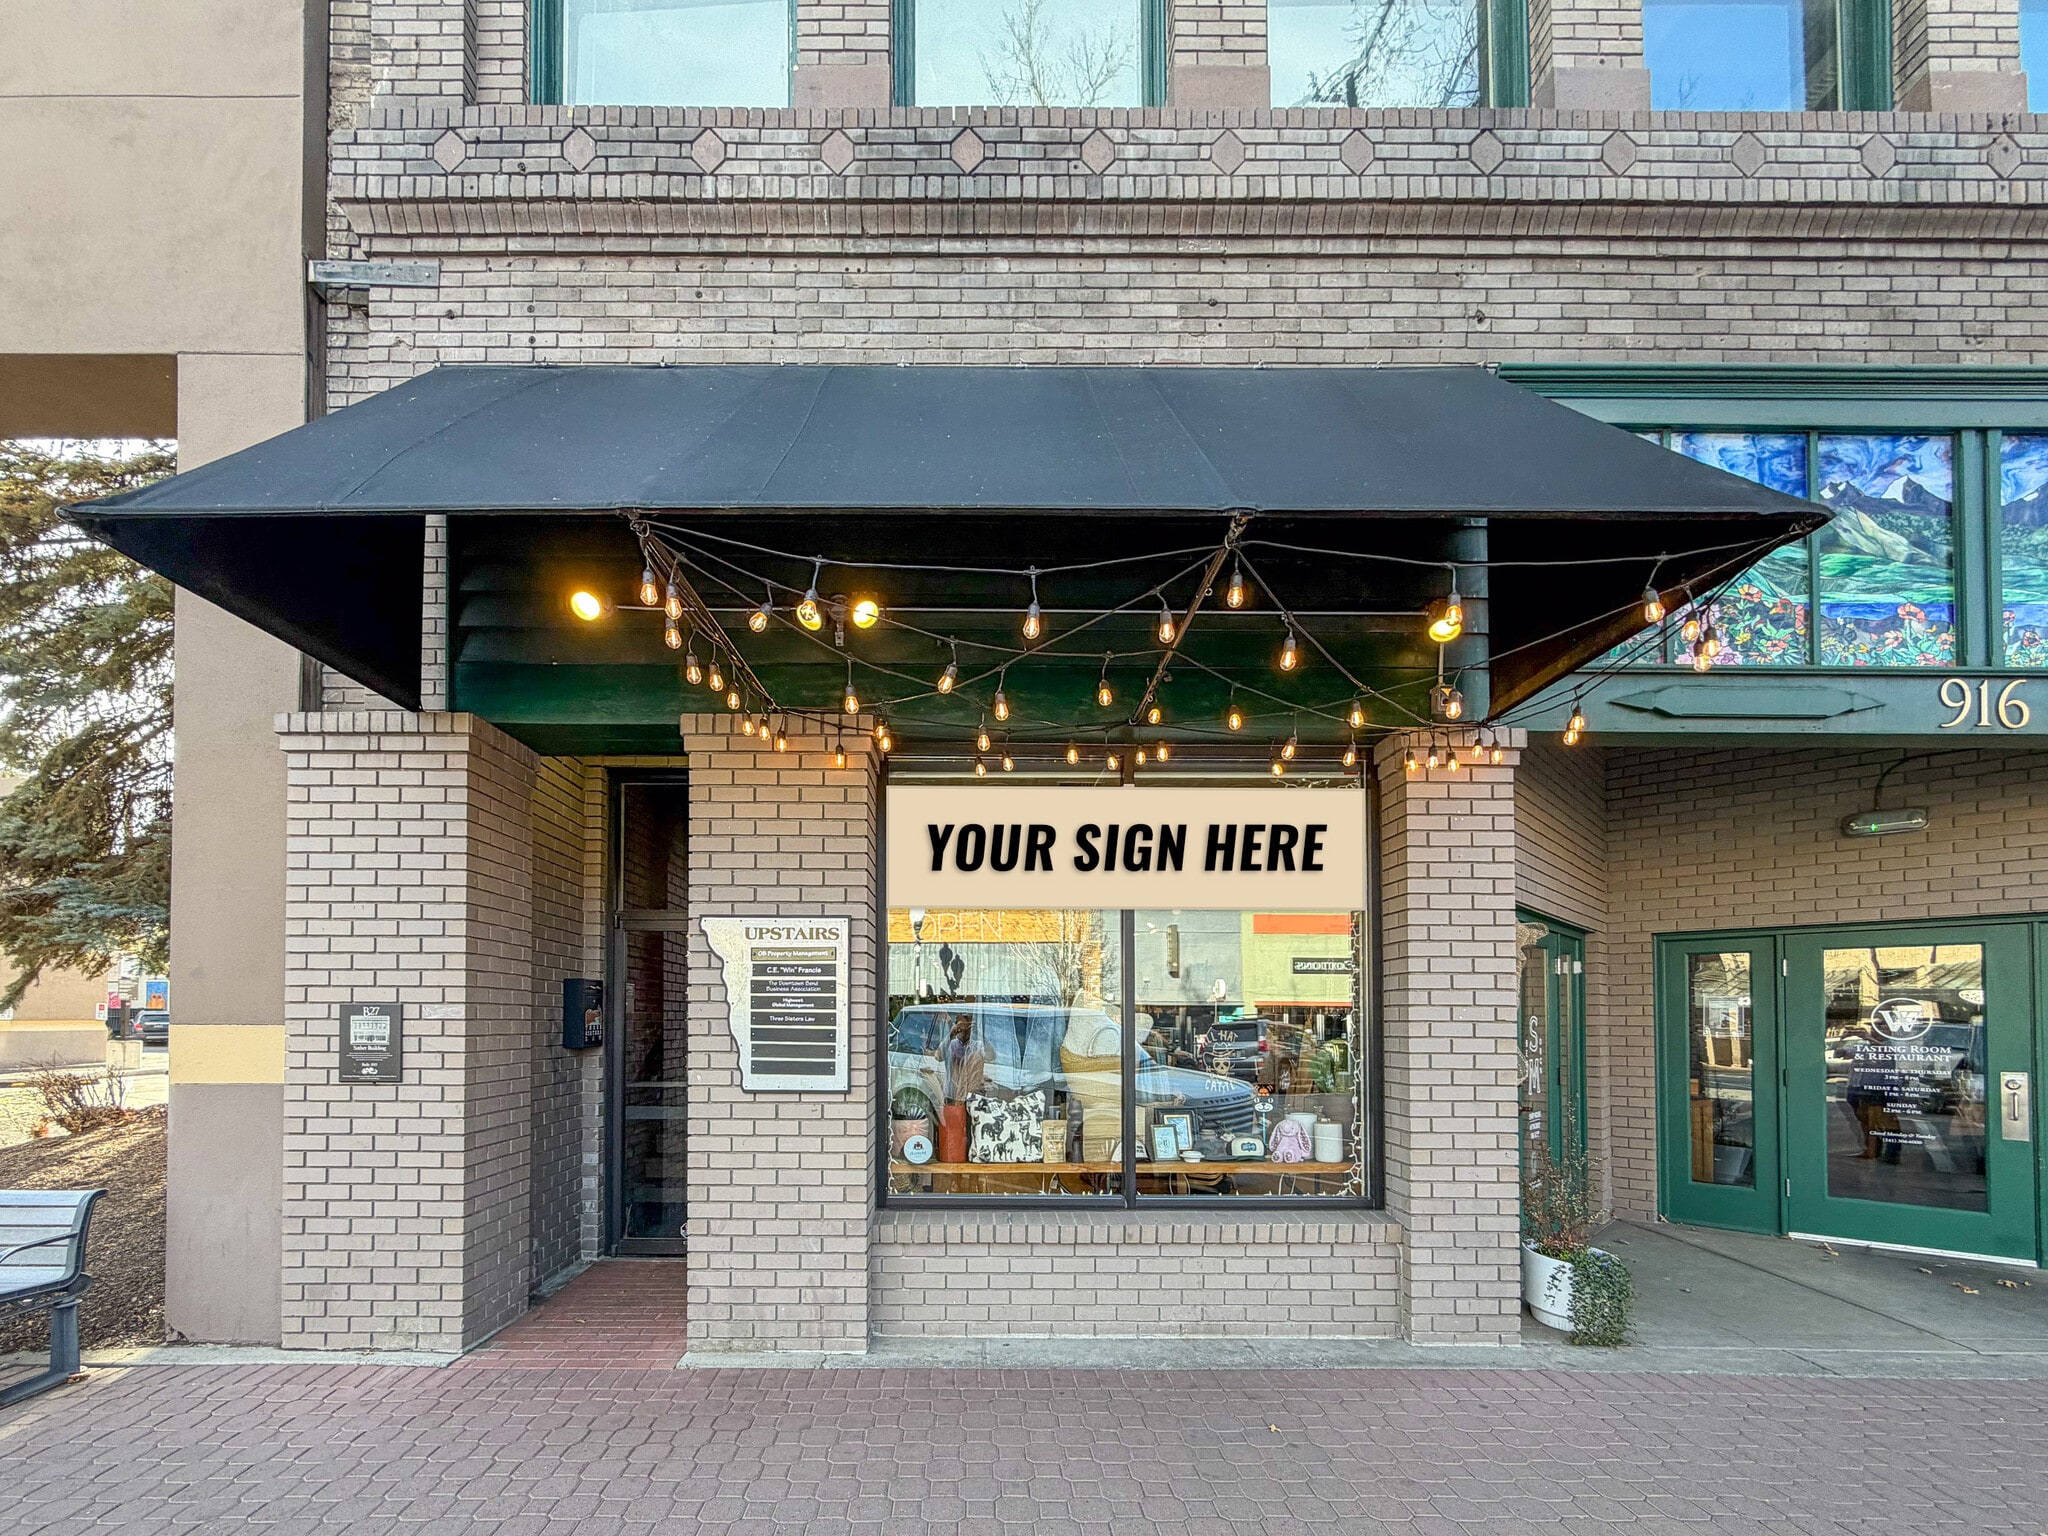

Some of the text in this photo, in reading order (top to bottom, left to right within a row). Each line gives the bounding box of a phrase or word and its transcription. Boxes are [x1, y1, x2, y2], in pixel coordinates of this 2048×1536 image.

[1940, 678, 2030, 729] 916
[927, 823, 1328, 873] YOUR SIGN HERE
[744, 927, 840, 940] UPSTAIRS
[1853, 1044, 1952, 1054] TASTING ROOM
[1854, 1052, 1952, 1062] & RESTAURANT
